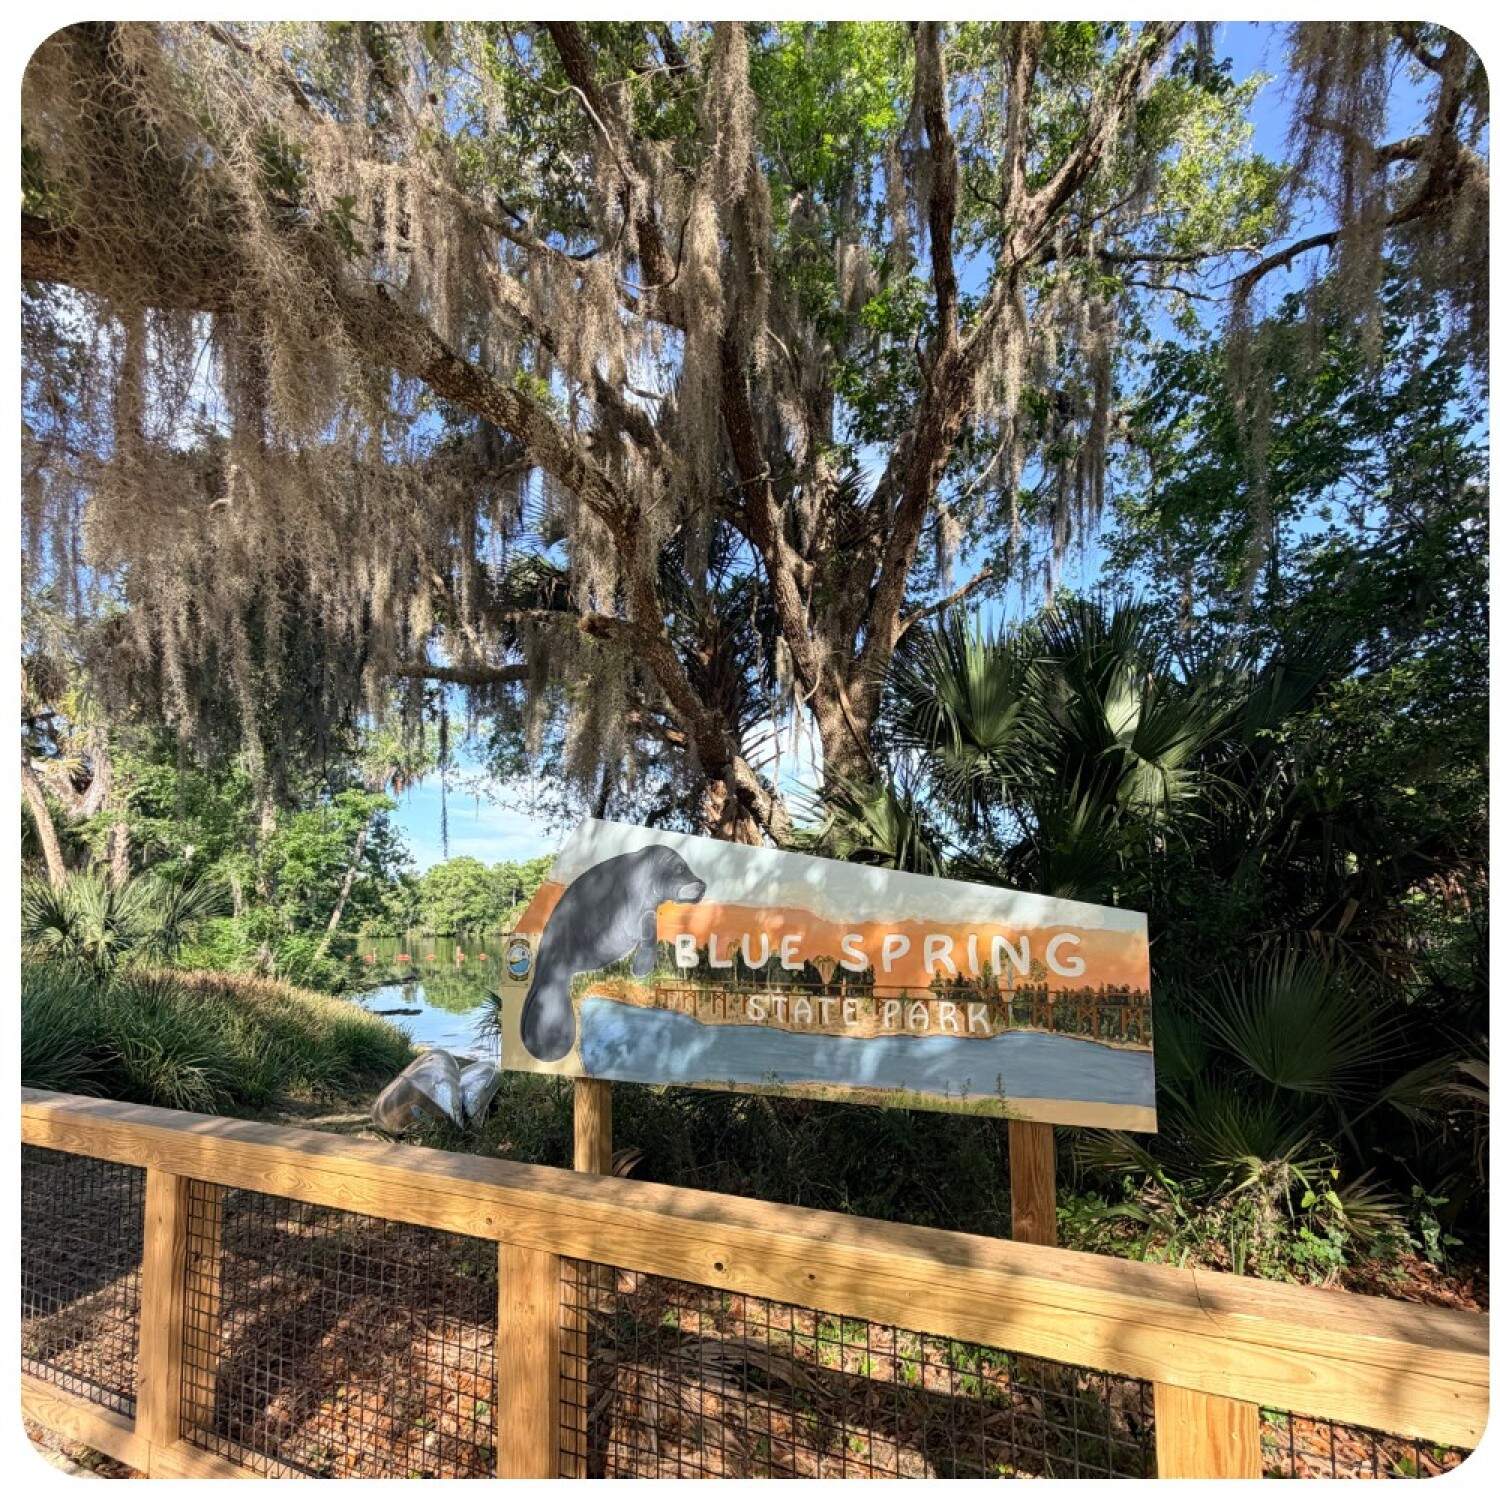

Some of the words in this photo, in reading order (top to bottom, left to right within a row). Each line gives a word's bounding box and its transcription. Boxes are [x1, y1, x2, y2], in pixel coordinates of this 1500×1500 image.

[675, 933, 805, 969] BLUE
[841, 933, 1086, 977] SPRING
[748, 994, 859, 1026] STATE
[883, 1000, 991, 1034] PARK
